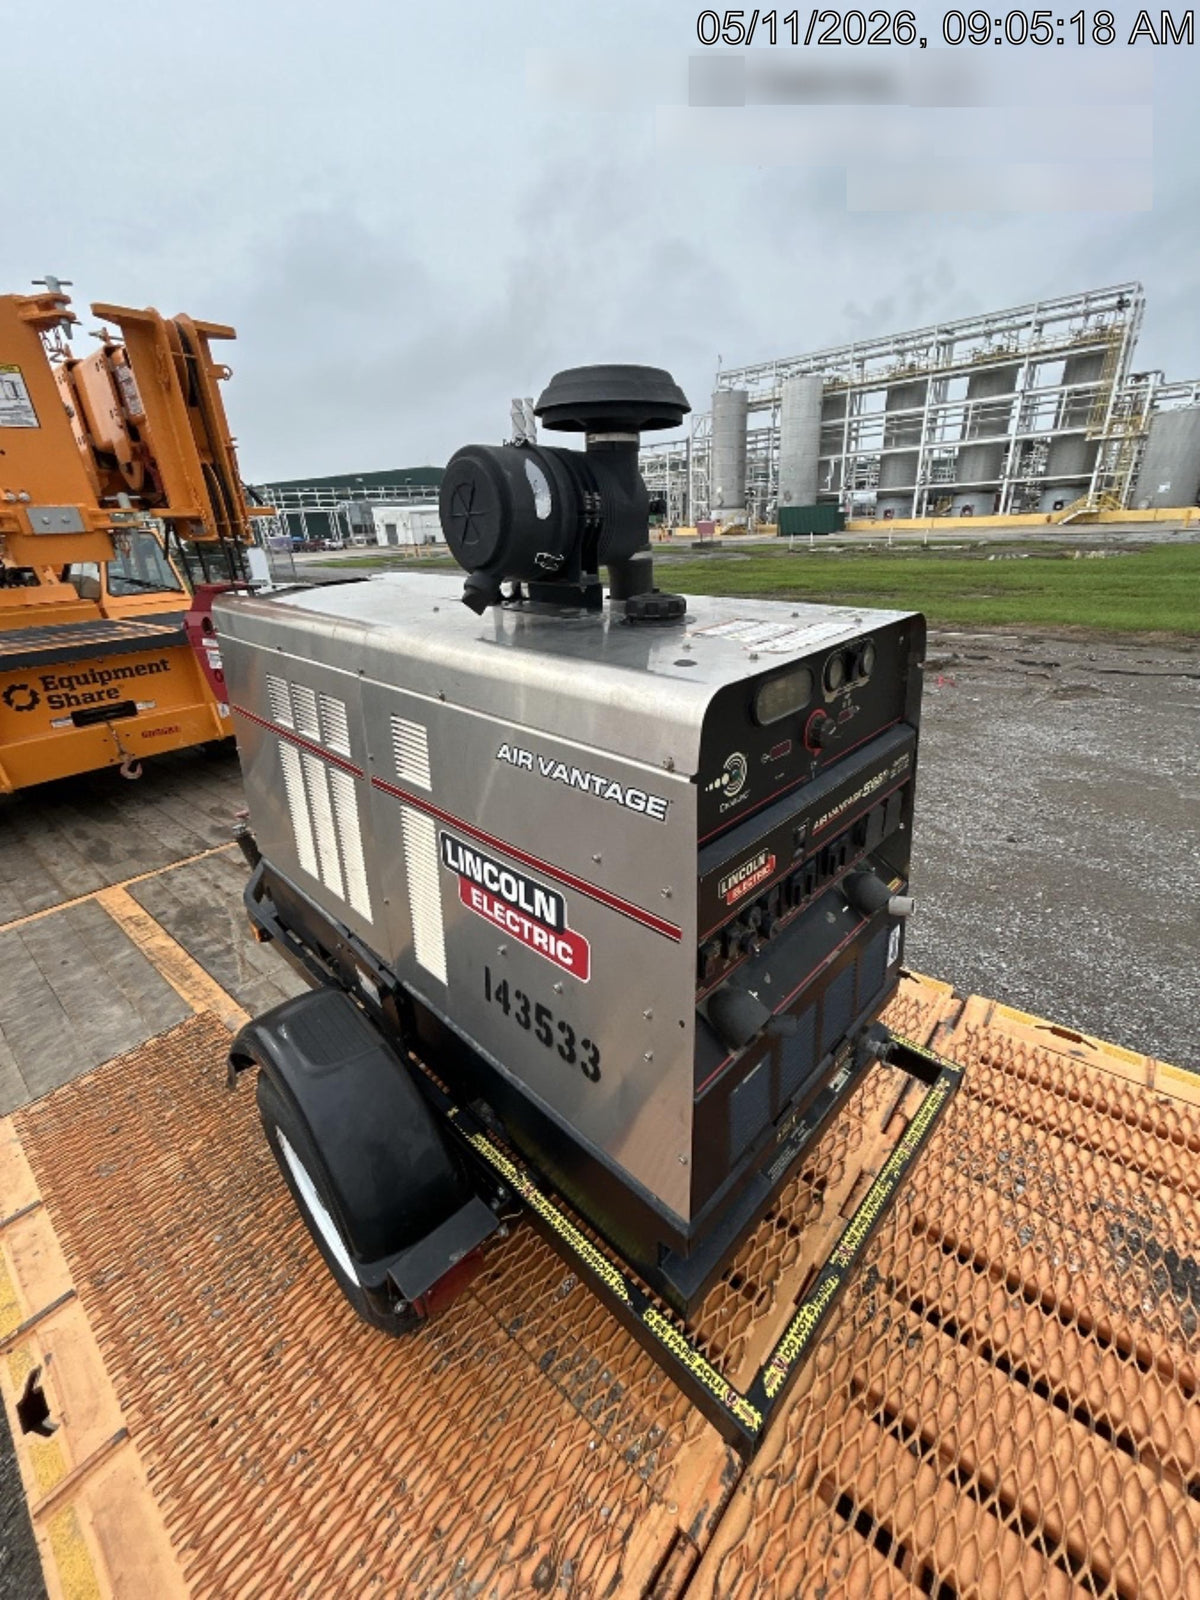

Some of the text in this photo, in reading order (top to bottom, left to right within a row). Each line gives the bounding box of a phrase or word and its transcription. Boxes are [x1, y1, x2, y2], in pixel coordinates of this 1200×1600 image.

[39, 659, 171, 692] Equipment
[47, 687, 120, 710] Share
[497, 743, 534, 771] AIR
[538, 756, 668, 821] VANTAGE
[445, 839, 557, 926] LINCOLN
[720, 852, 767, 894] LINCOLN
[470, 888, 574, 967] ELECTRIC
[485, 966, 601, 1083] 143533
[666, 1333, 698, 1364] PARE
[780, 1338, 799, 1358] DO
[790, 1314, 811, 1339] NOT
